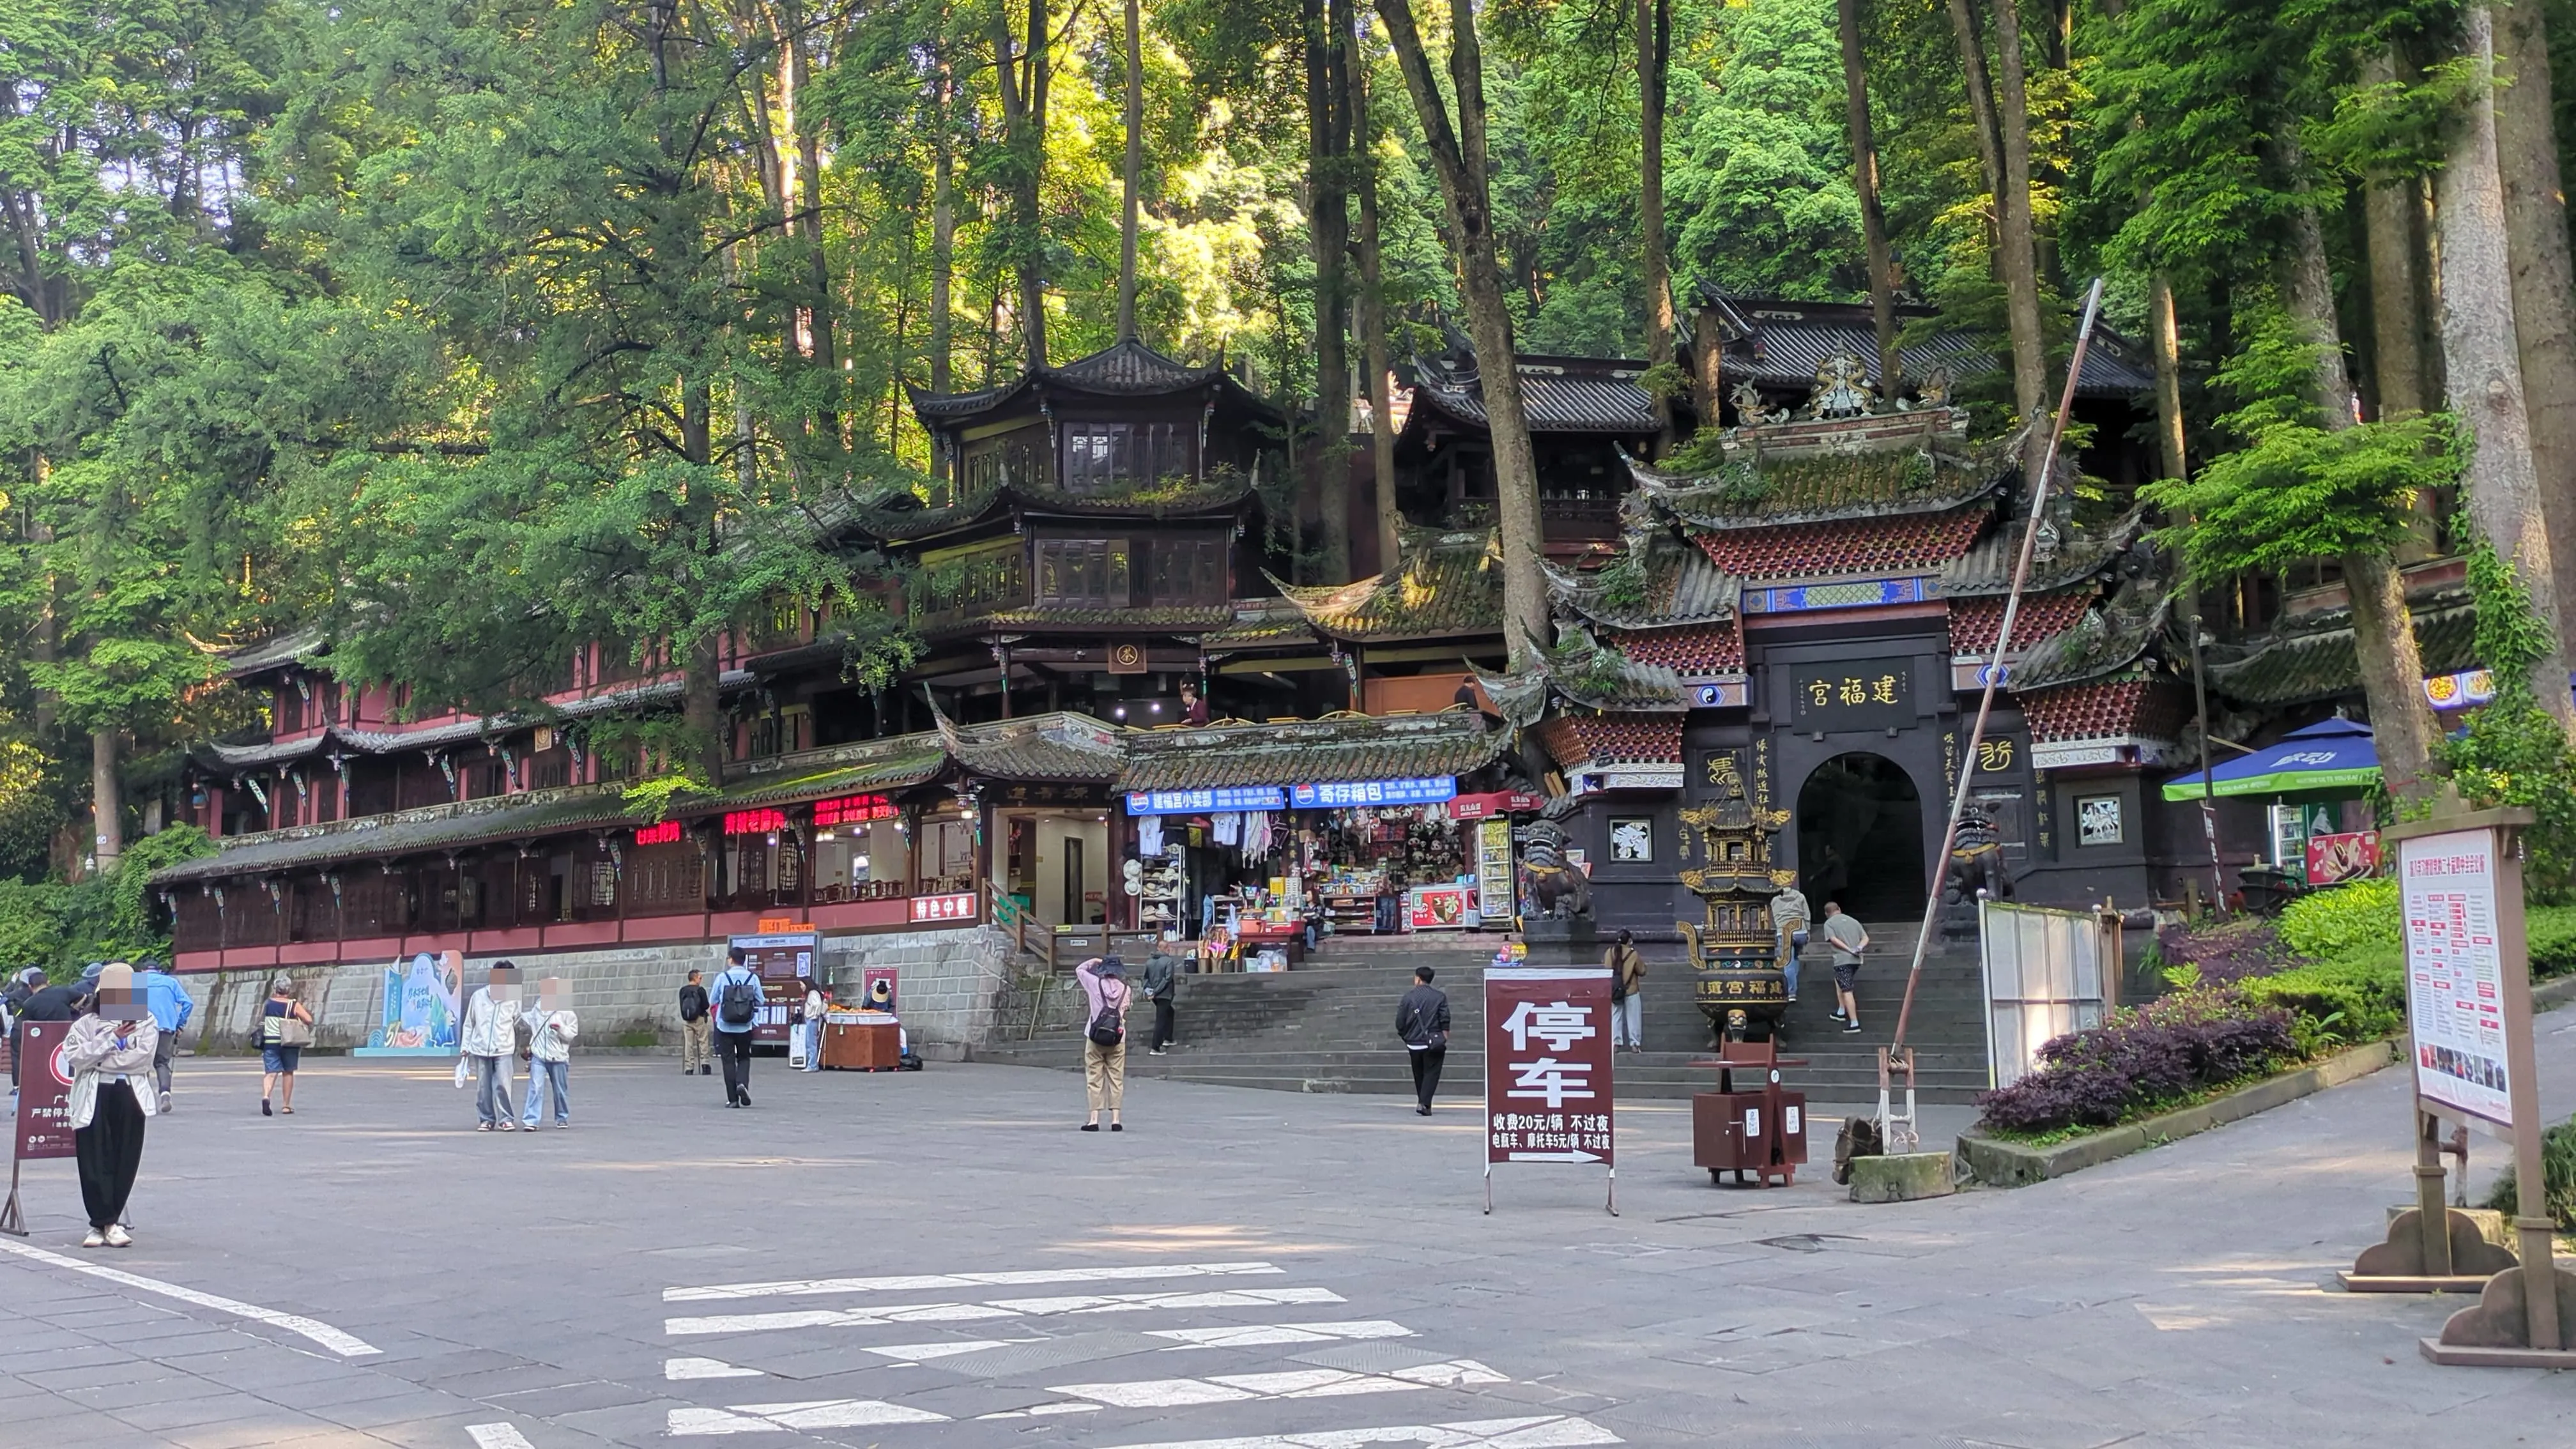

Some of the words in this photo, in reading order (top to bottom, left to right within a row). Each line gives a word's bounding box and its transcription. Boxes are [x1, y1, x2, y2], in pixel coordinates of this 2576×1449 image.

[1153, 791, 1212, 809] 建福宫小卖部
[1319, 783, 1382, 803] 寄存箱包
[916, 897, 967, 919] 特色中餐
[1501, 1001, 1595, 1108] 停车
[1493, 1113, 1563, 1131] 收费20元/辆
[1570, 1114, 1609, 1131] 不过夜
[1583, 1133, 1610, 1149] 不过夜
